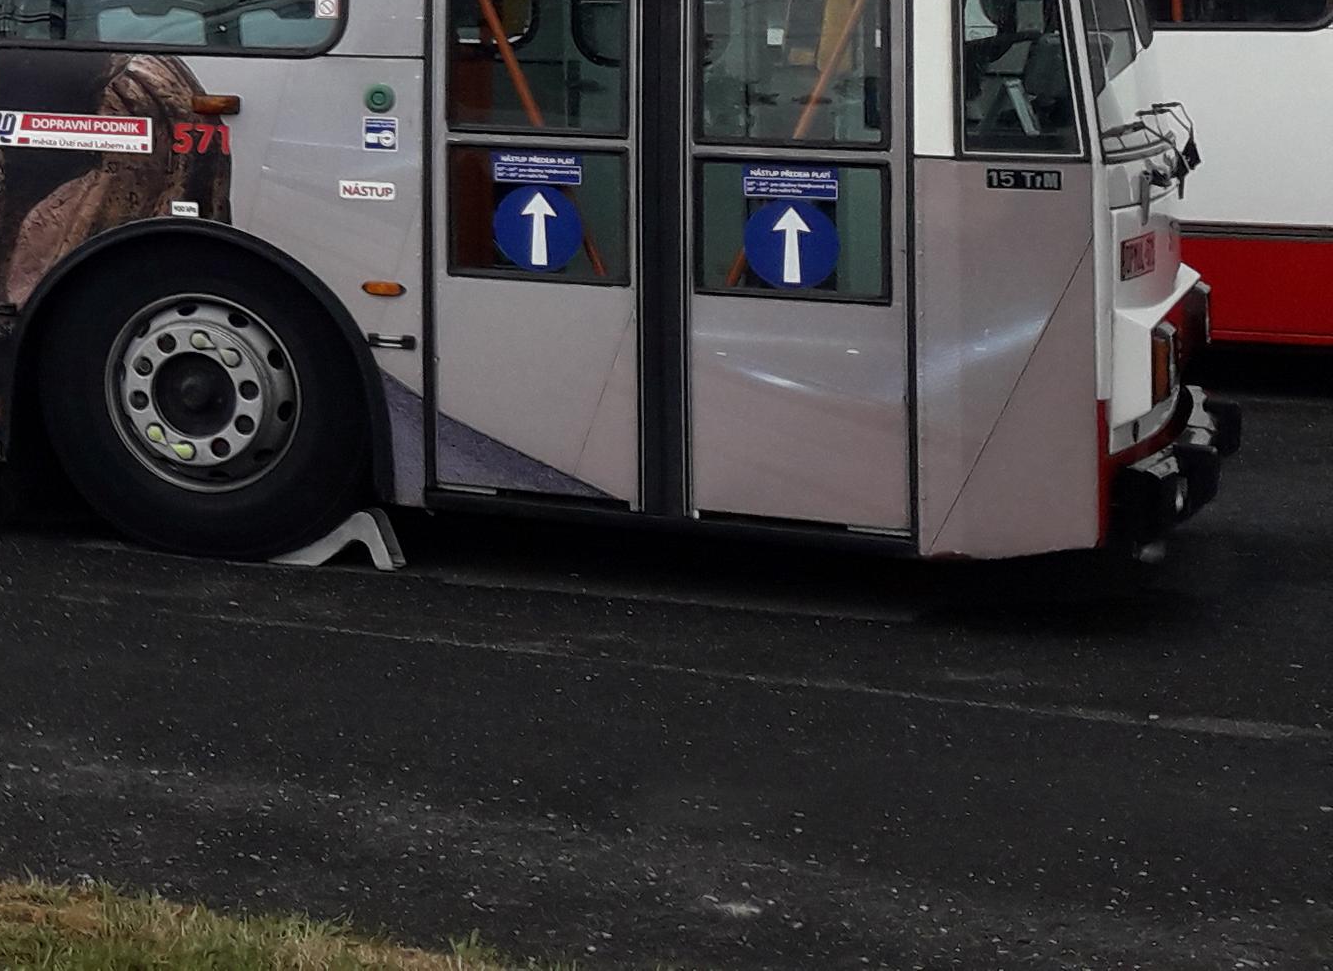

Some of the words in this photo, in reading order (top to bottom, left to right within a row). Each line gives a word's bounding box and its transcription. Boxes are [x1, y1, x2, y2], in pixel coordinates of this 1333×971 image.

[31, 118, 92, 131] DOPRAVNÍ
[92, 119, 140, 133] PODNIK
[172, 122, 231, 156] 571
[988, 171, 1014, 187] 15
[1020, 172, 1059, 188] TrM
[342, 183, 393, 197] NÁSTUP
